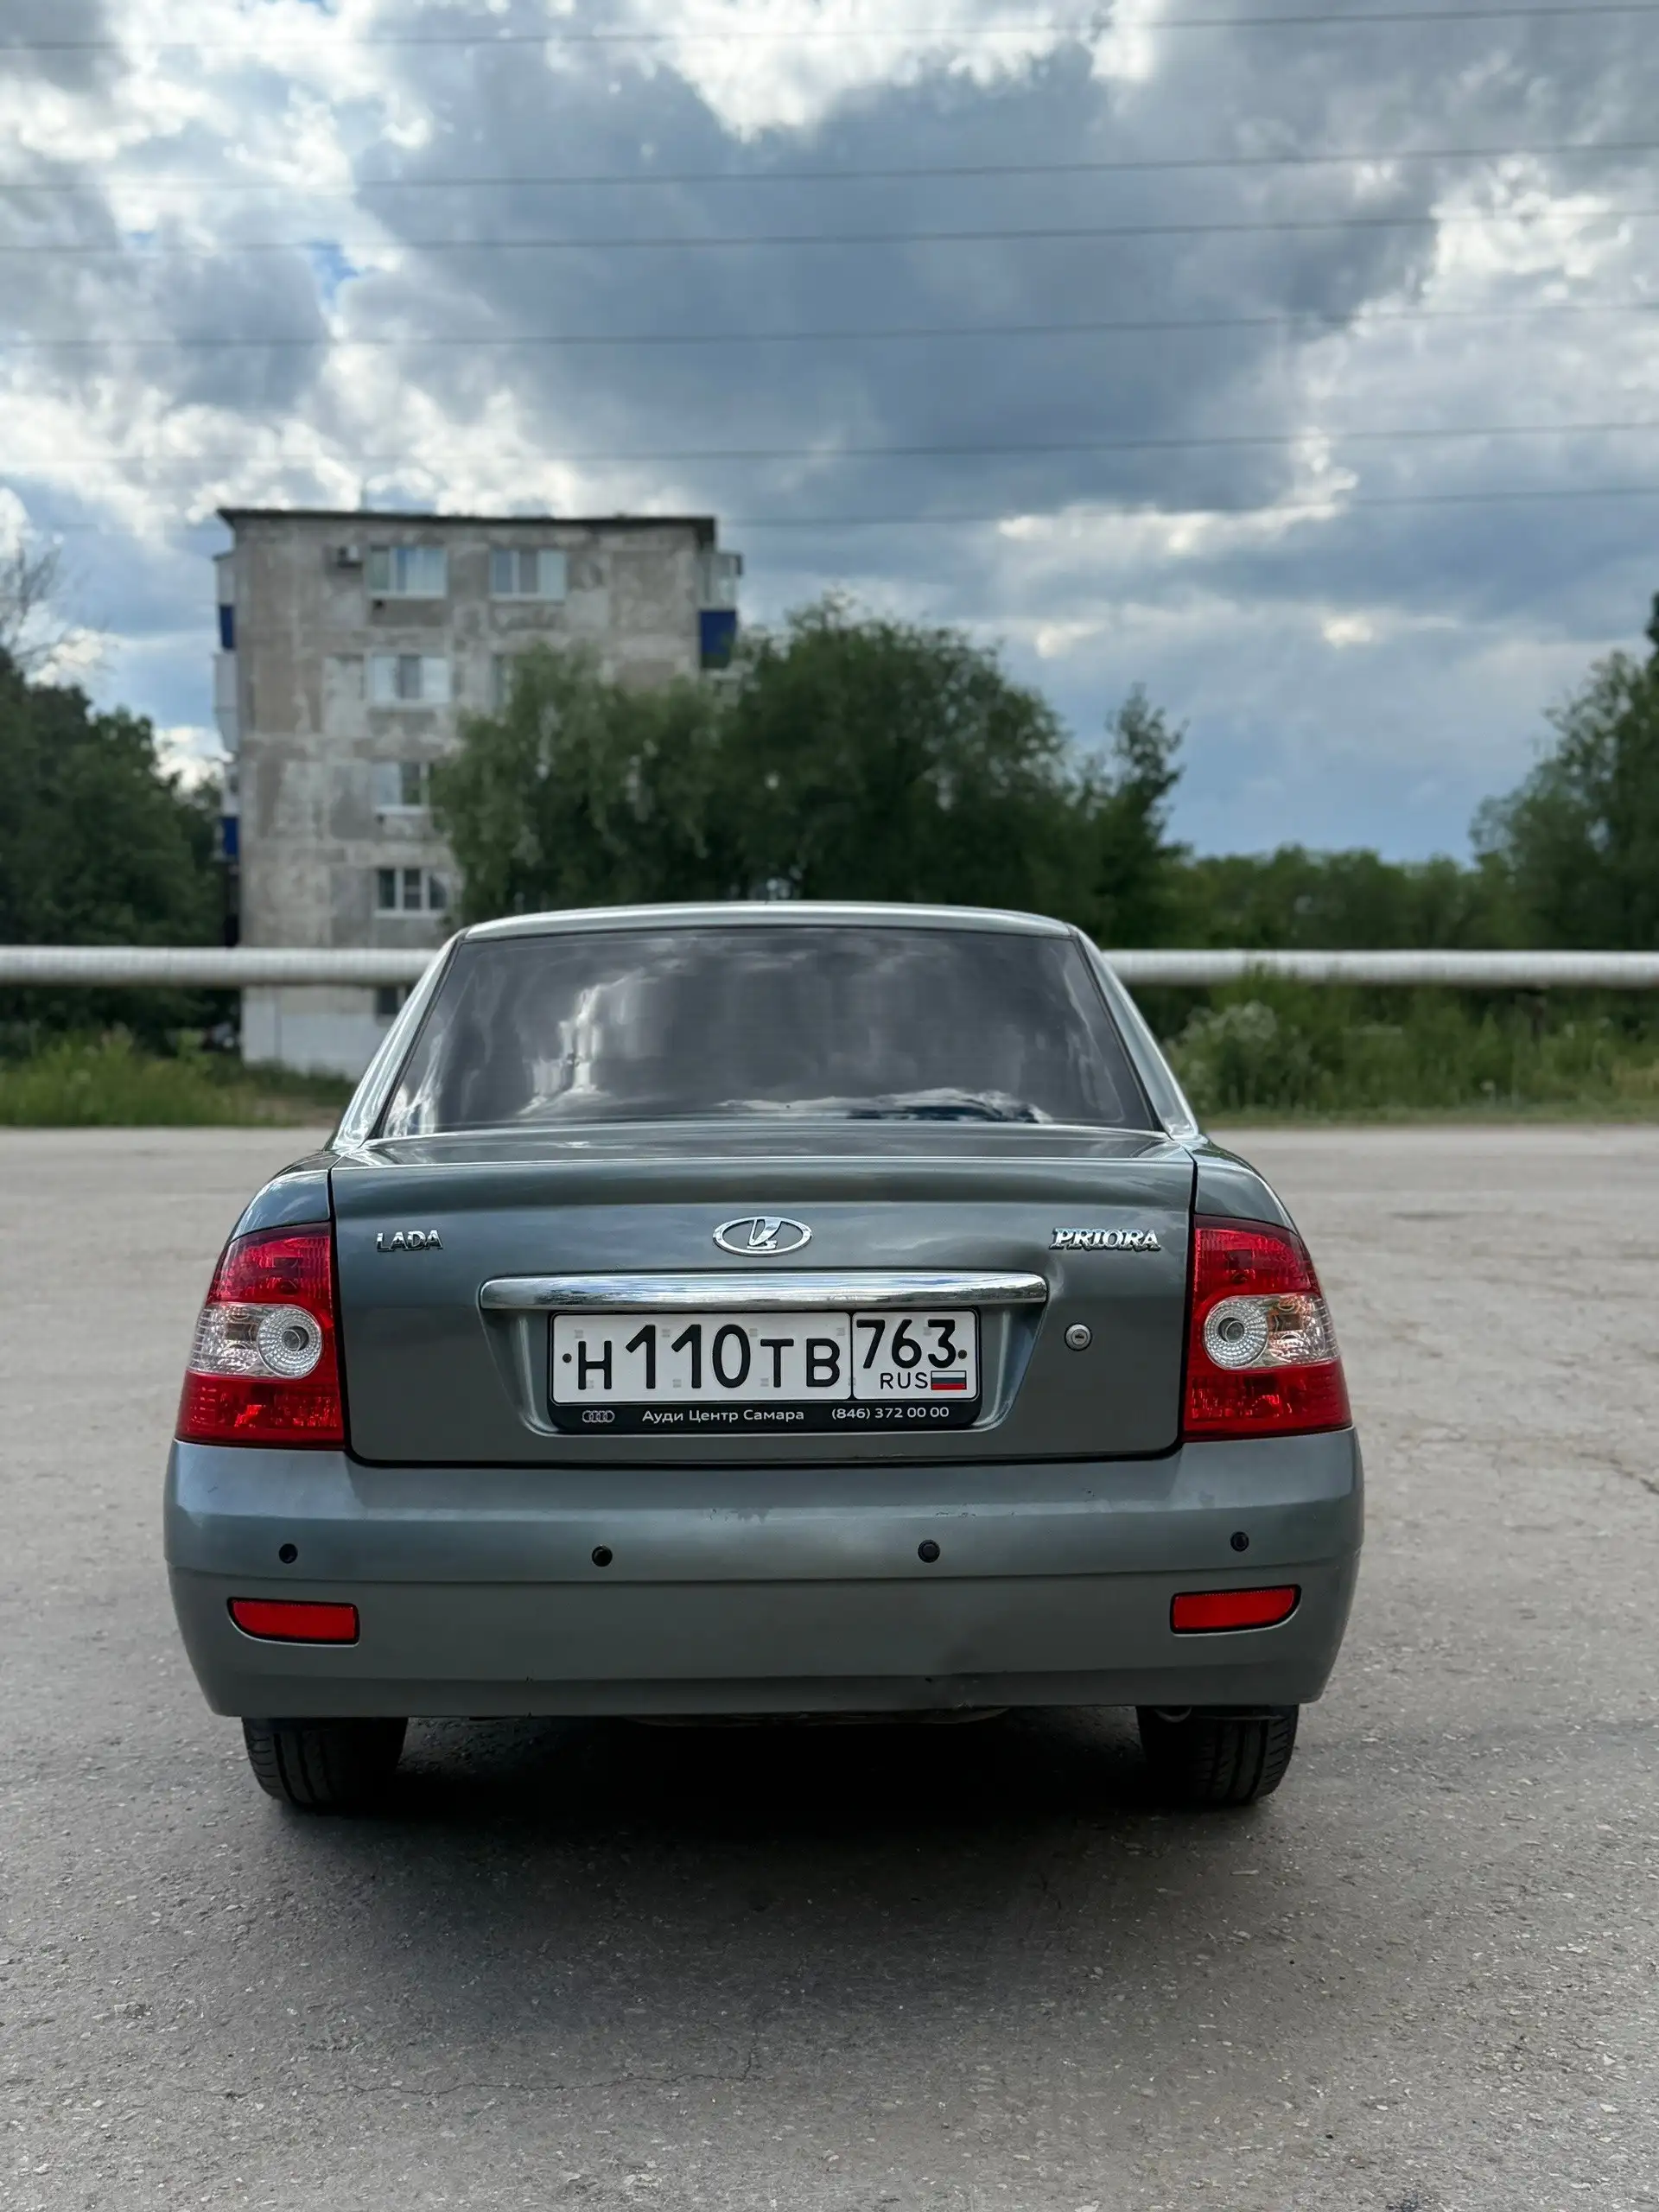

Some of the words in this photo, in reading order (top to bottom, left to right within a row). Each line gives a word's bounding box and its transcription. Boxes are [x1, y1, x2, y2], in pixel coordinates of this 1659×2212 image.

[376, 1230, 443, 1252] LADA
[1049, 1227, 1161, 1252] PRIORA
[856, 1319, 957, 1369] 763
[880, 1371, 928, 1390] RUS
[642, 1410, 683, 1423] Ауди
[689, 1409, 739, 1423] Центр
[743, 1408, 804, 1422] Самара
[831, 1408, 870, 1420] (846)
[874, 1408, 903, 1419] 372
[906, 1407, 926, 1418] 00
[930, 1407, 950, 1417] 00
